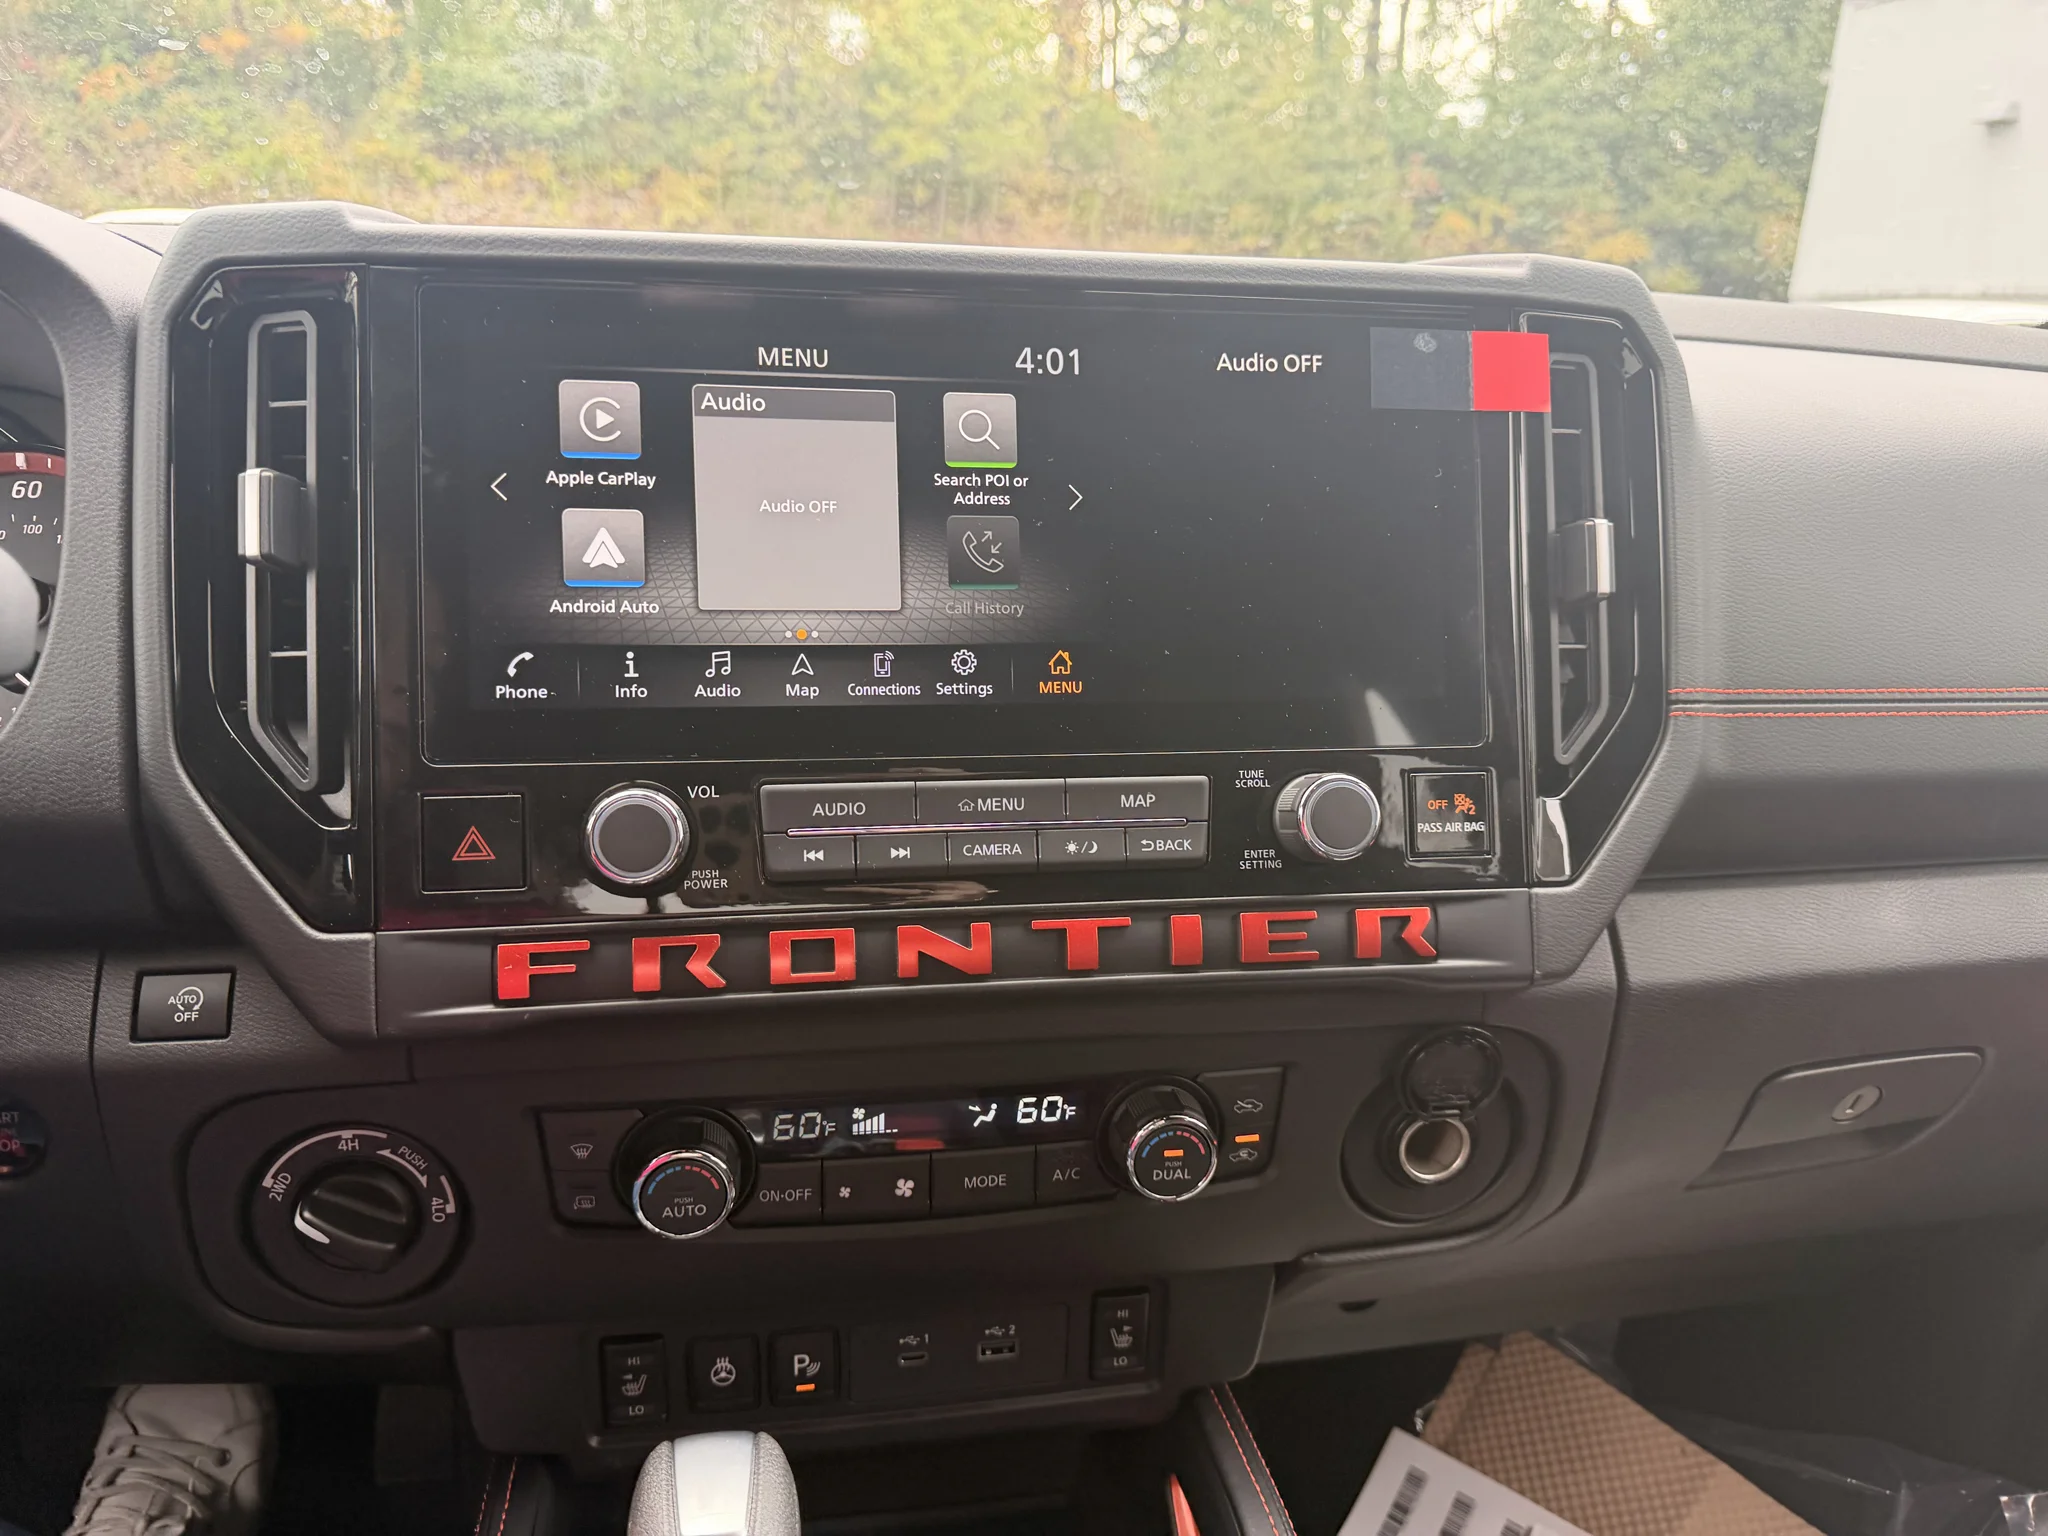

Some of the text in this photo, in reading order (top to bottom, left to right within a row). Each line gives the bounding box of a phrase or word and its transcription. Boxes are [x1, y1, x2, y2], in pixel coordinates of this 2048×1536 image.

[758, 346, 829, 369] MENU
[1015, 347, 1081, 375] 4:01
[1216, 352, 1323, 373] Audio OFF
[700, 391, 766, 412] Audio
[546, 470, 657, 489] Apple CarPlay
[934, 473, 1029, 487] Search POI or
[11, 480, 43, 499] 60
[953, 492, 1011, 505] Address
[759, 499, 838, 514] Audio OFF
[23, 524, 43, 534] 100
[549, 599, 660, 614] Android Auto
[945, 602, 1025, 618] Call History
[495, 685, 548, 699] Phone
[615, 683, 648, 698] Info
[694, 684, 741, 698] Audio
[785, 684, 820, 699] Map
[847, 683, 921, 696] Connections
[935, 682, 994, 698] Settings
[1039, 681, 1083, 694] MENU
[1238, 770, 1265, 780] TUNE
[1235, 778, 1271, 788] SCROLL
[687, 785, 720, 799] VOL
[977, 797, 1025, 812] MENU
[1120, 793, 1156, 808] MAP
[1427, 799, 1448, 810] OFF
[812, 802, 866, 817] AUDIO
[1417, 821, 1485, 833] PASS AIR BAG
[963, 843, 1022, 856] CAMERA
[1156, 839, 1192, 852] BACK
[1244, 849, 1276, 859] ENTER
[1239, 859, 1282, 870] SETTING
[691, 869, 719, 879] PUSH
[684, 878, 728, 890] POWER
[497, 906, 1437, 1000] FRONTIER
[168, 995, 197, 1005] AUTO
[174, 1011, 199, 1023] OFF
[338, 1139, 360, 1151] 4H
[397, 1145, 428, 1170] PUSH
[1165, 1160, 1182, 1168] PUSH
[964, 1174, 1007, 1189] MODE
[1052, 1167, 1081, 1182] A/C
[1153, 1168, 1191, 1181] DUAL
[269, 1172, 292, 1202] 2WD
[674, 1196, 694, 1204] PUSH
[431, 1196, 446, 1223] 4LO
[662, 1204, 707, 1219] AUTO
[1117, 1309, 1129, 1319] HI
[1008, 1325, 1016, 1335] 2
[627, 1356, 640, 1366] HI
[793, 1354, 810, 1377] P
[1113, 1356, 1128, 1367] LO
[629, 1405, 644, 1416] LO
